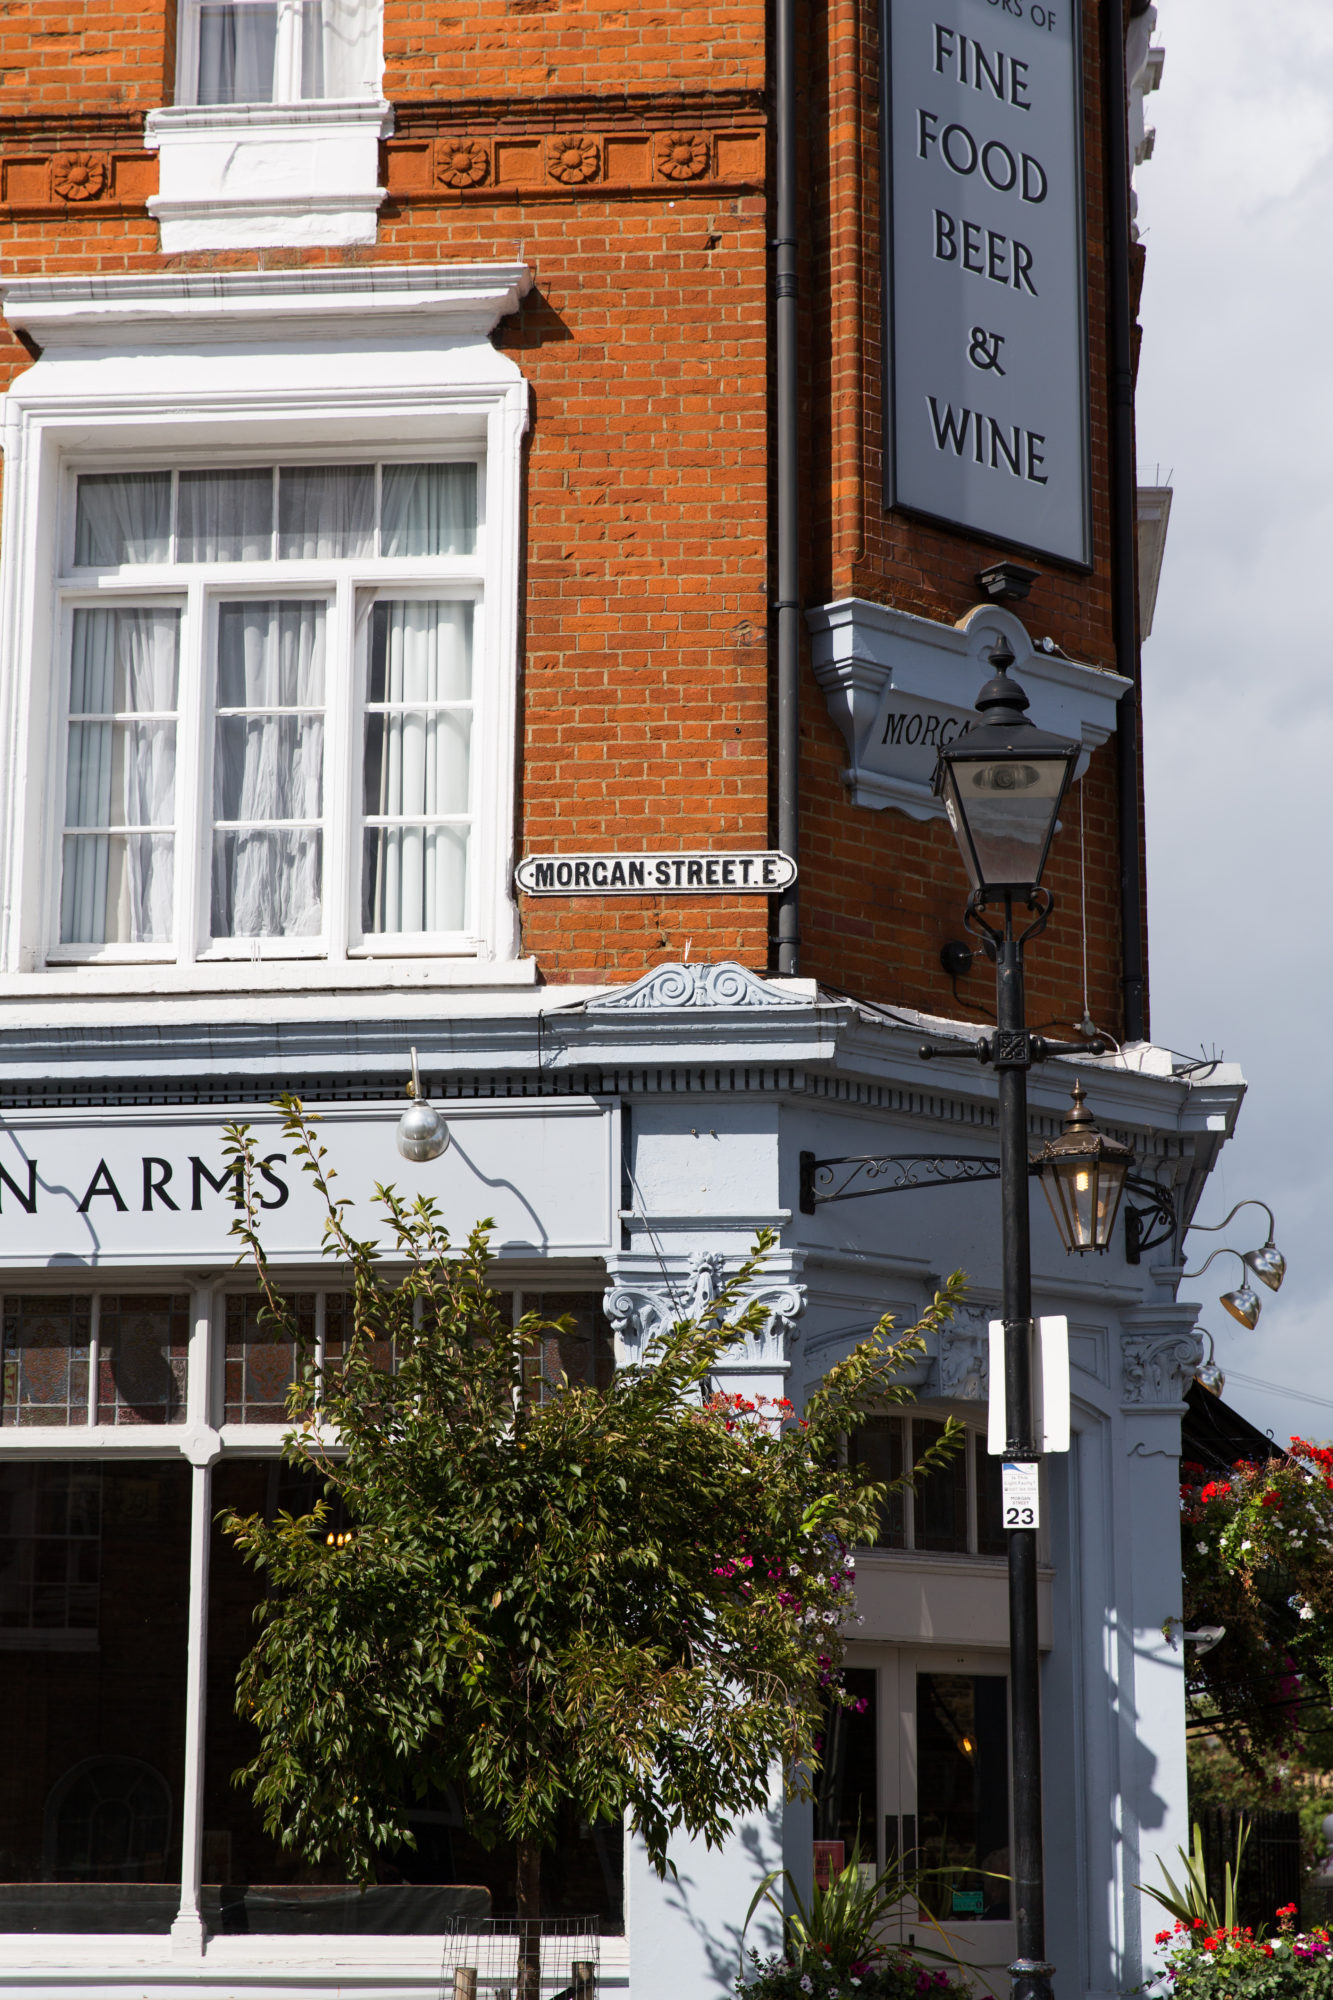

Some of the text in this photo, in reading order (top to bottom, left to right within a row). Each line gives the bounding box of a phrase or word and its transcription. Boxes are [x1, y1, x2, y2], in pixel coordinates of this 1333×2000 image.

[1030, 4, 1056, 32] OF
[933, 23, 1032, 111] FINE
[916, 109, 1048, 204] FOOD
[933, 209, 1038, 297] BEER
[968, 327, 1006, 376] &
[926, 396, 1049, 485] WINE
[534, 861, 645, 887] MORGAN
[76, 1153, 290, 1213] ARMS
[1006, 1507, 1034, 1525] 23
